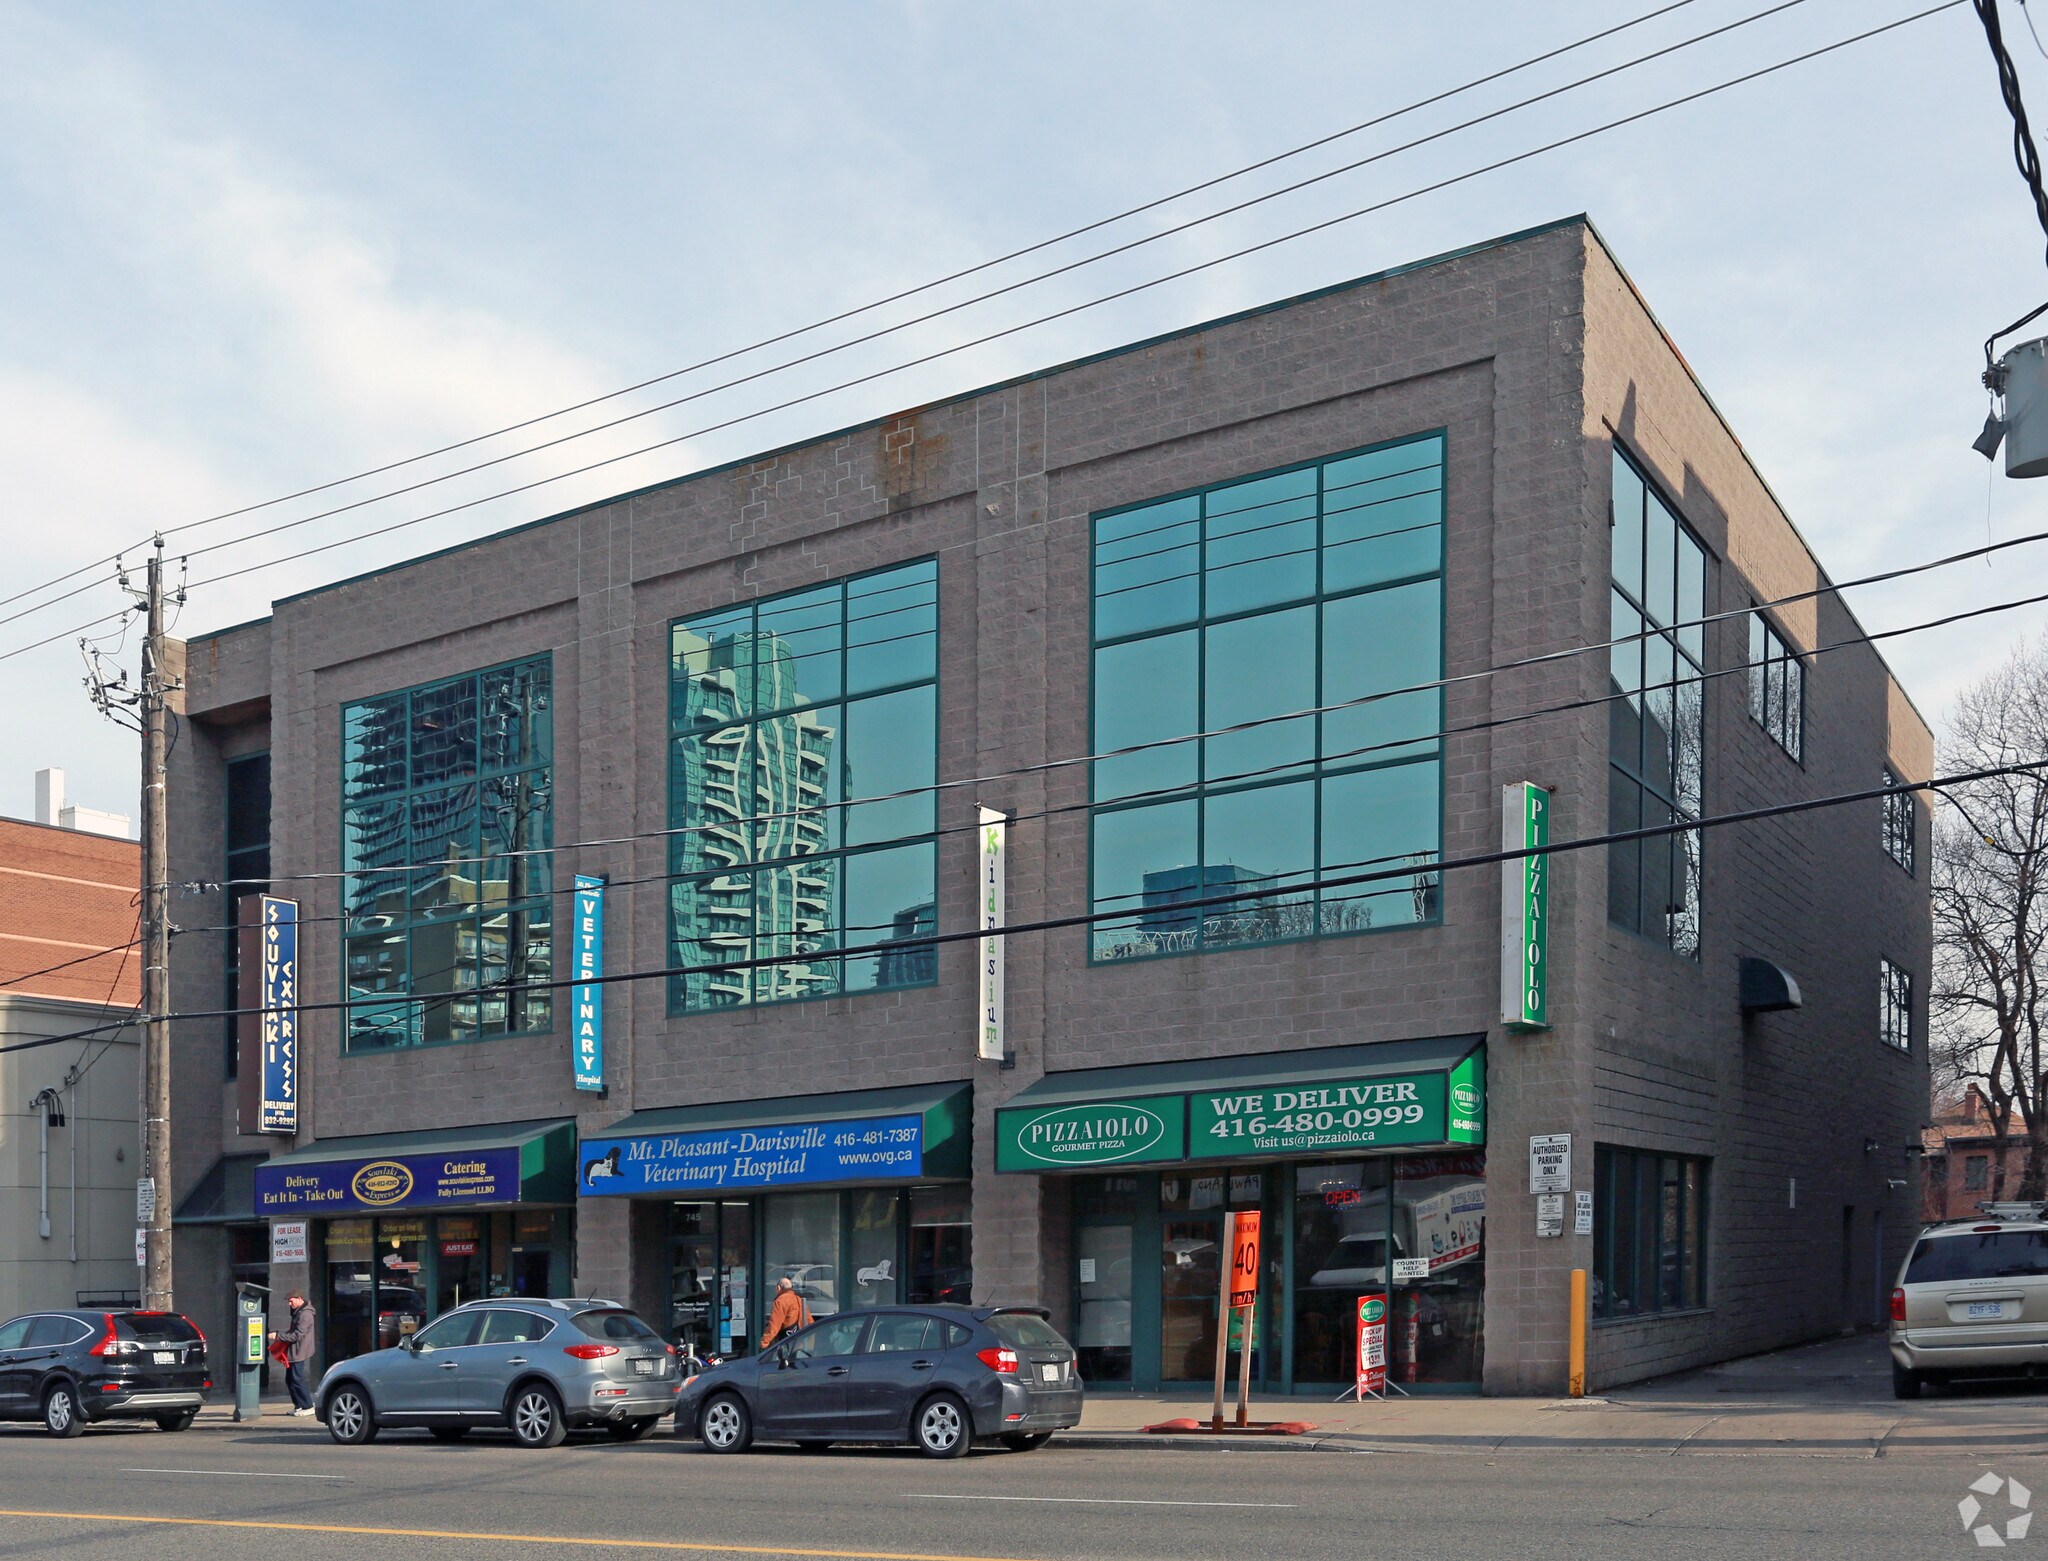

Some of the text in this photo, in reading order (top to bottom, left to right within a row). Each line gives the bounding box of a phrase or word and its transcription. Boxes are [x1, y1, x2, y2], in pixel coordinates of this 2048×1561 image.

[1528, 798, 1543, 1011] PIZZAIOLO
[266, 904, 280, 1063] SOUVLAKI
[580, 899, 596, 1070] VETERINARY
[576, 1074, 601, 1085] Hospital
[1210, 1083, 1419, 1116] WE DELIVER
[1455, 1090, 1480, 1103] PIZZAIOLO
[264, 1101, 294, 1110] DELIVERY
[264, 1116, 294, 1125] 932-9292
[1210, 1104, 1424, 1138] 416-480-0999
[1031, 1116, 1149, 1143] PIZZAIOLO
[833, 1128, 918, 1148] 416-481-7387
[1253, 1130, 1376, 1149] Visit us@pizzaiolo.ca
[627, 1131, 826, 1161] Mt. Pleasant-Davisville
[1051, 1140, 1125, 1153] GOURMET PIZZA
[1533, 1144, 1567, 1155] AUTHORIZED
[838, 1150, 913, 1166] www.ovg.ca
[1538, 1156, 1563, 1165] PARKING
[444, 1161, 486, 1176] Catering
[643, 1153, 806, 1185] Veterinary Hospital
[1543, 1166, 1557, 1175] ONLY
[286, 1176, 320, 1189] Delivery
[264, 1193, 277, 1204] Eat
[280, 1192, 287, 1202] It
[288, 1192, 297, 1202] In
[305, 1190, 326, 1201] Take
[327, 1188, 344, 1200] Out
[369, 1190, 395, 1201] Express
[438, 1189, 451, 1198] Fully
[453, 1187, 475, 1195] Licensed
[1325, 1190, 1361, 1204] OPEN
[685, 1213, 701, 1222] 745
[289, 1237, 304, 1245] POINT
[1235, 1242, 1255, 1276] 40
[1232, 1291, 1252, 1305] km/h
[1365, 1328, 1375, 1336] PICK
[1362, 1335, 1383, 1346] SPECIAL
